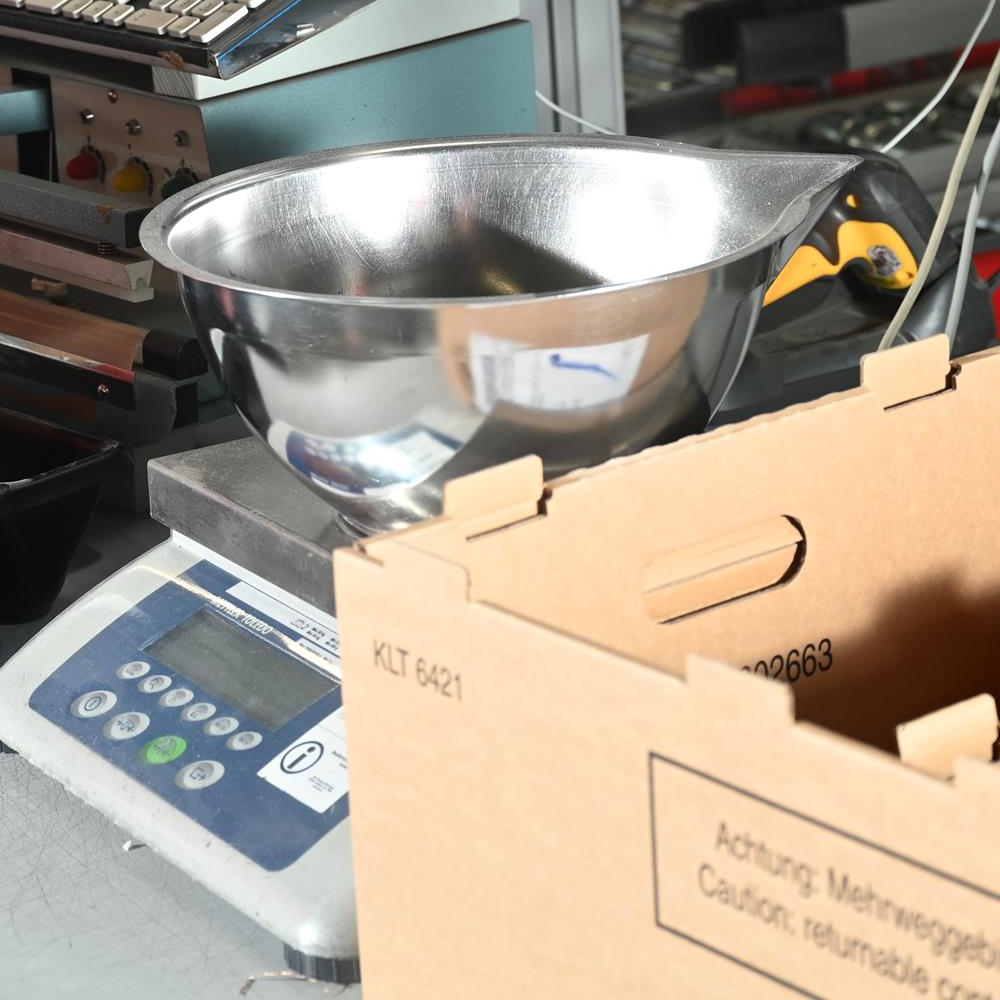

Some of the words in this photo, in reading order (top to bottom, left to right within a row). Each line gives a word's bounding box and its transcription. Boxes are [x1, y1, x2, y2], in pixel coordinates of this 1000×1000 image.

[241, 612, 274, 635] TOLEDO
[373, 638, 409, 678] KLT
[416, 657, 462, 702] 6421
[715, 822, 818, 899] Achtung:
[698, 862, 797, 937] Caution:
[803, 917, 930, 995] returnable
